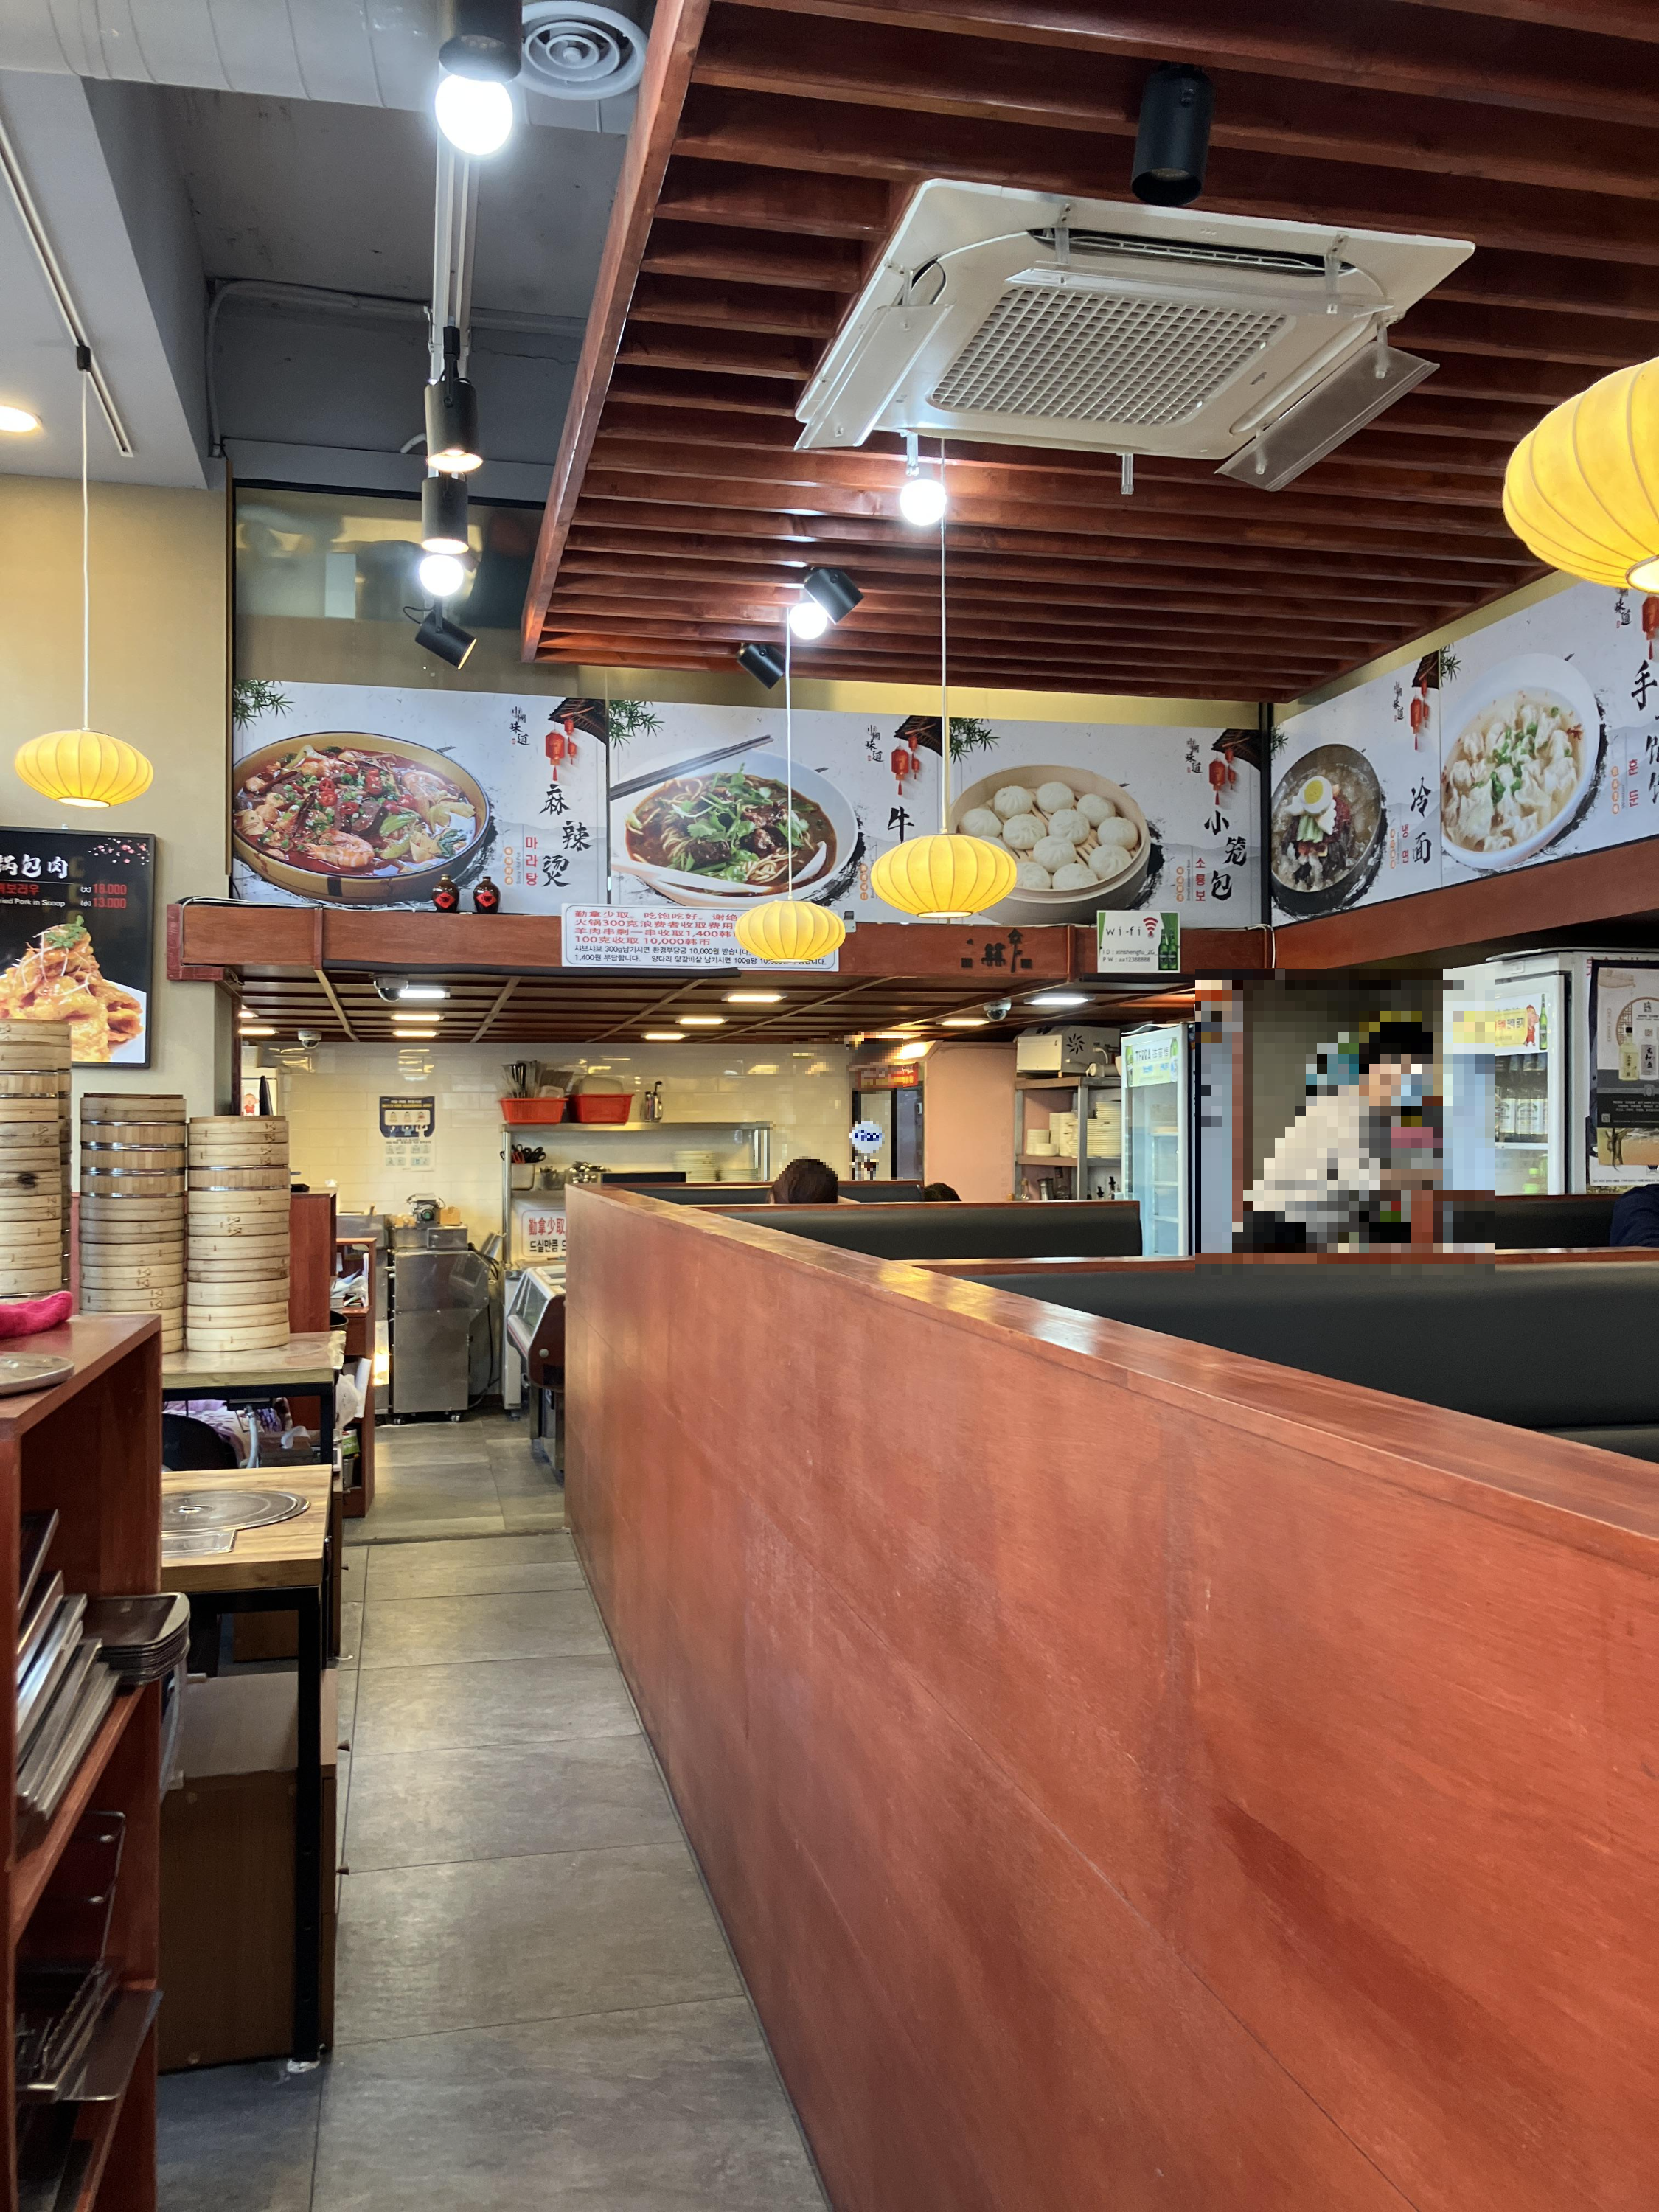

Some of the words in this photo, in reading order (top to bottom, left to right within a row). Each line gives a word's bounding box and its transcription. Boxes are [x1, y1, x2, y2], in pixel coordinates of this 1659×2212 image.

[526, 836, 538, 886] 마라탕
[1402, 824, 1409, 863] 냉면
[1195, 858, 1206, 901] 소룡보
[42, 899, 66, 907] Scoop
[529, 1239, 559, 1253] 드실만큼
